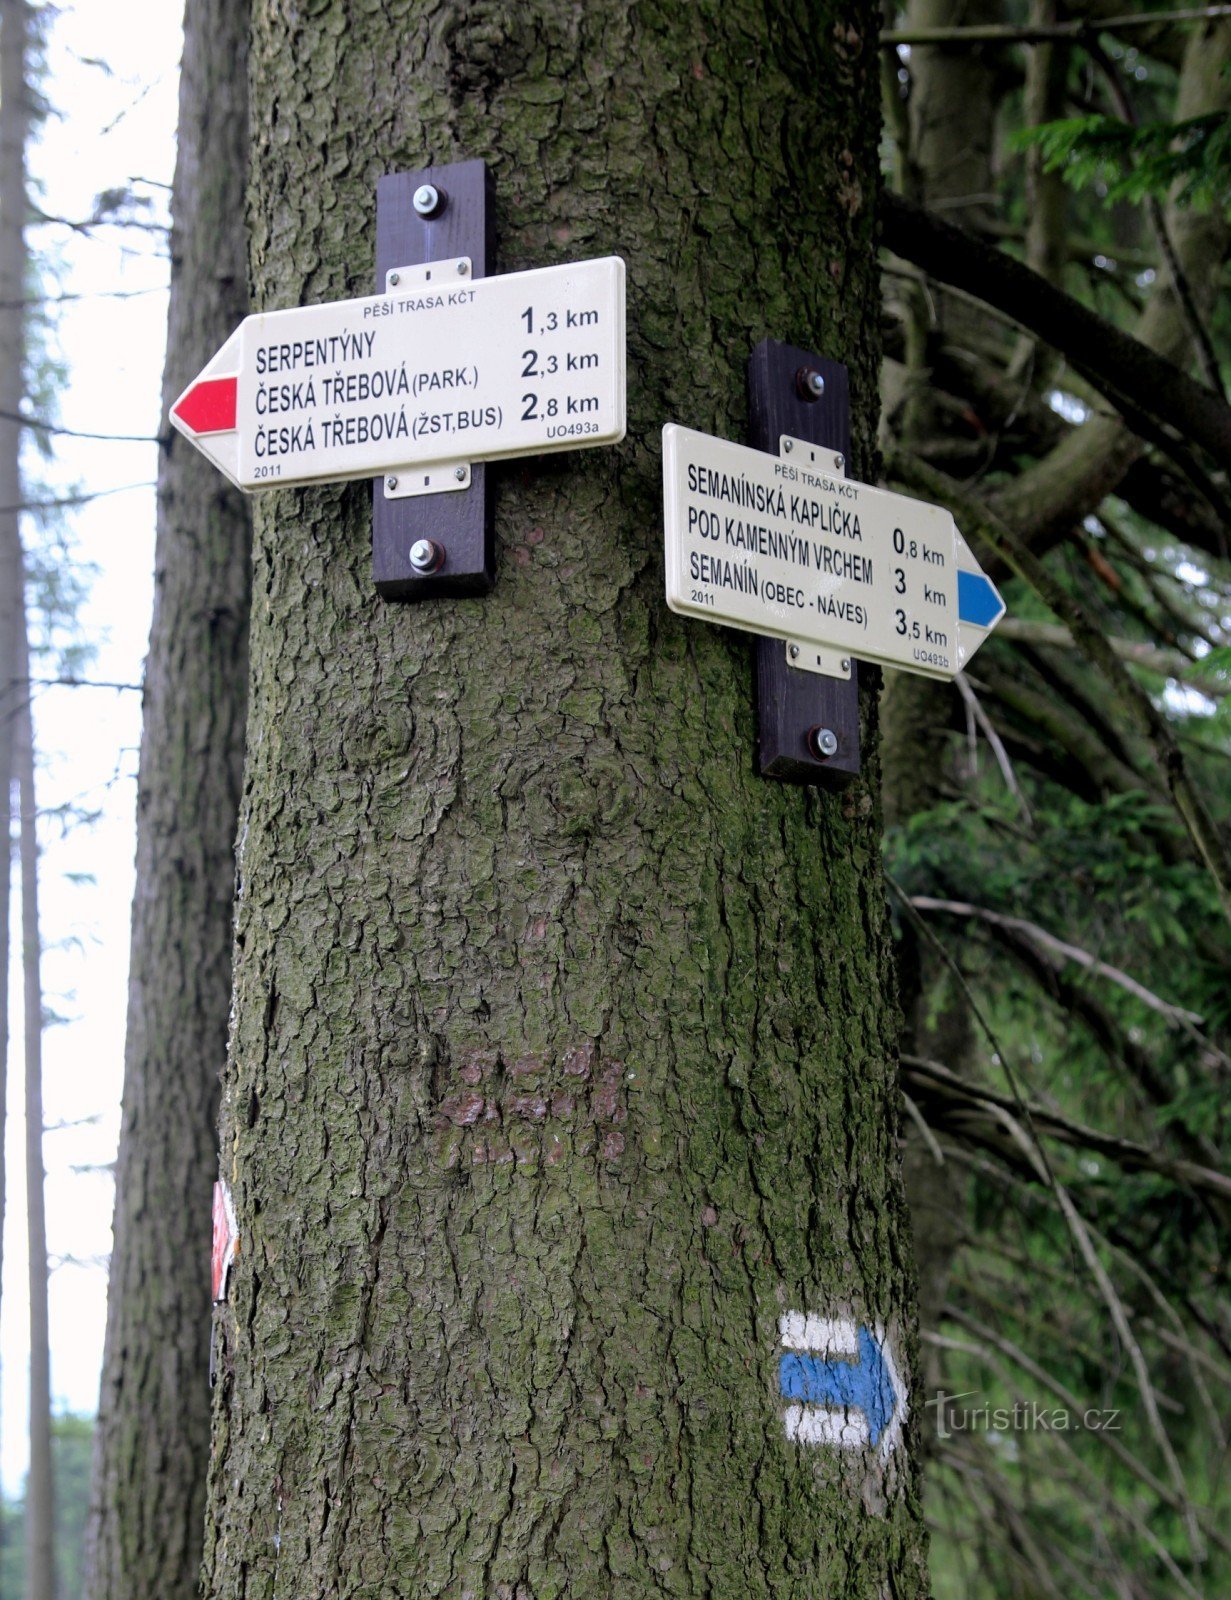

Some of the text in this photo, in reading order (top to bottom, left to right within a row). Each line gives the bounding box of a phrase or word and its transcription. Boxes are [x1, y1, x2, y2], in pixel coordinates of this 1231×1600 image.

[363, 291, 476, 319] PĚŠÍ TRASA KČT
[256, 307, 599, 374] SERPENTÝNY 1,3 km
[255, 376, 316, 415] ČESKÁ
[521, 350, 559, 378] 2,3
[566, 351, 599, 370] km
[254, 418, 315, 457] ČESKÁ
[521, 393, 559, 421] 2,8
[566, 394, 599, 414] km
[546, 422, 599, 438] UO493a
[254, 464, 282, 479] 2011
[774, 464, 858, 499] PĚŠÍ TRASA KČT
[688, 463, 945, 566] SEMANÍNSKÁ KAPLIČKA 0,8 km
[688, 507, 946, 606] POD KAMENNÝM VRCHEM 3 km
[690, 551, 758, 596] SEMANÍN
[818, 593, 867, 629] NÁVES)
[895, 609, 921, 640] 3,5
[925, 625, 947, 646] km
[691, 590, 714, 606] 2011
